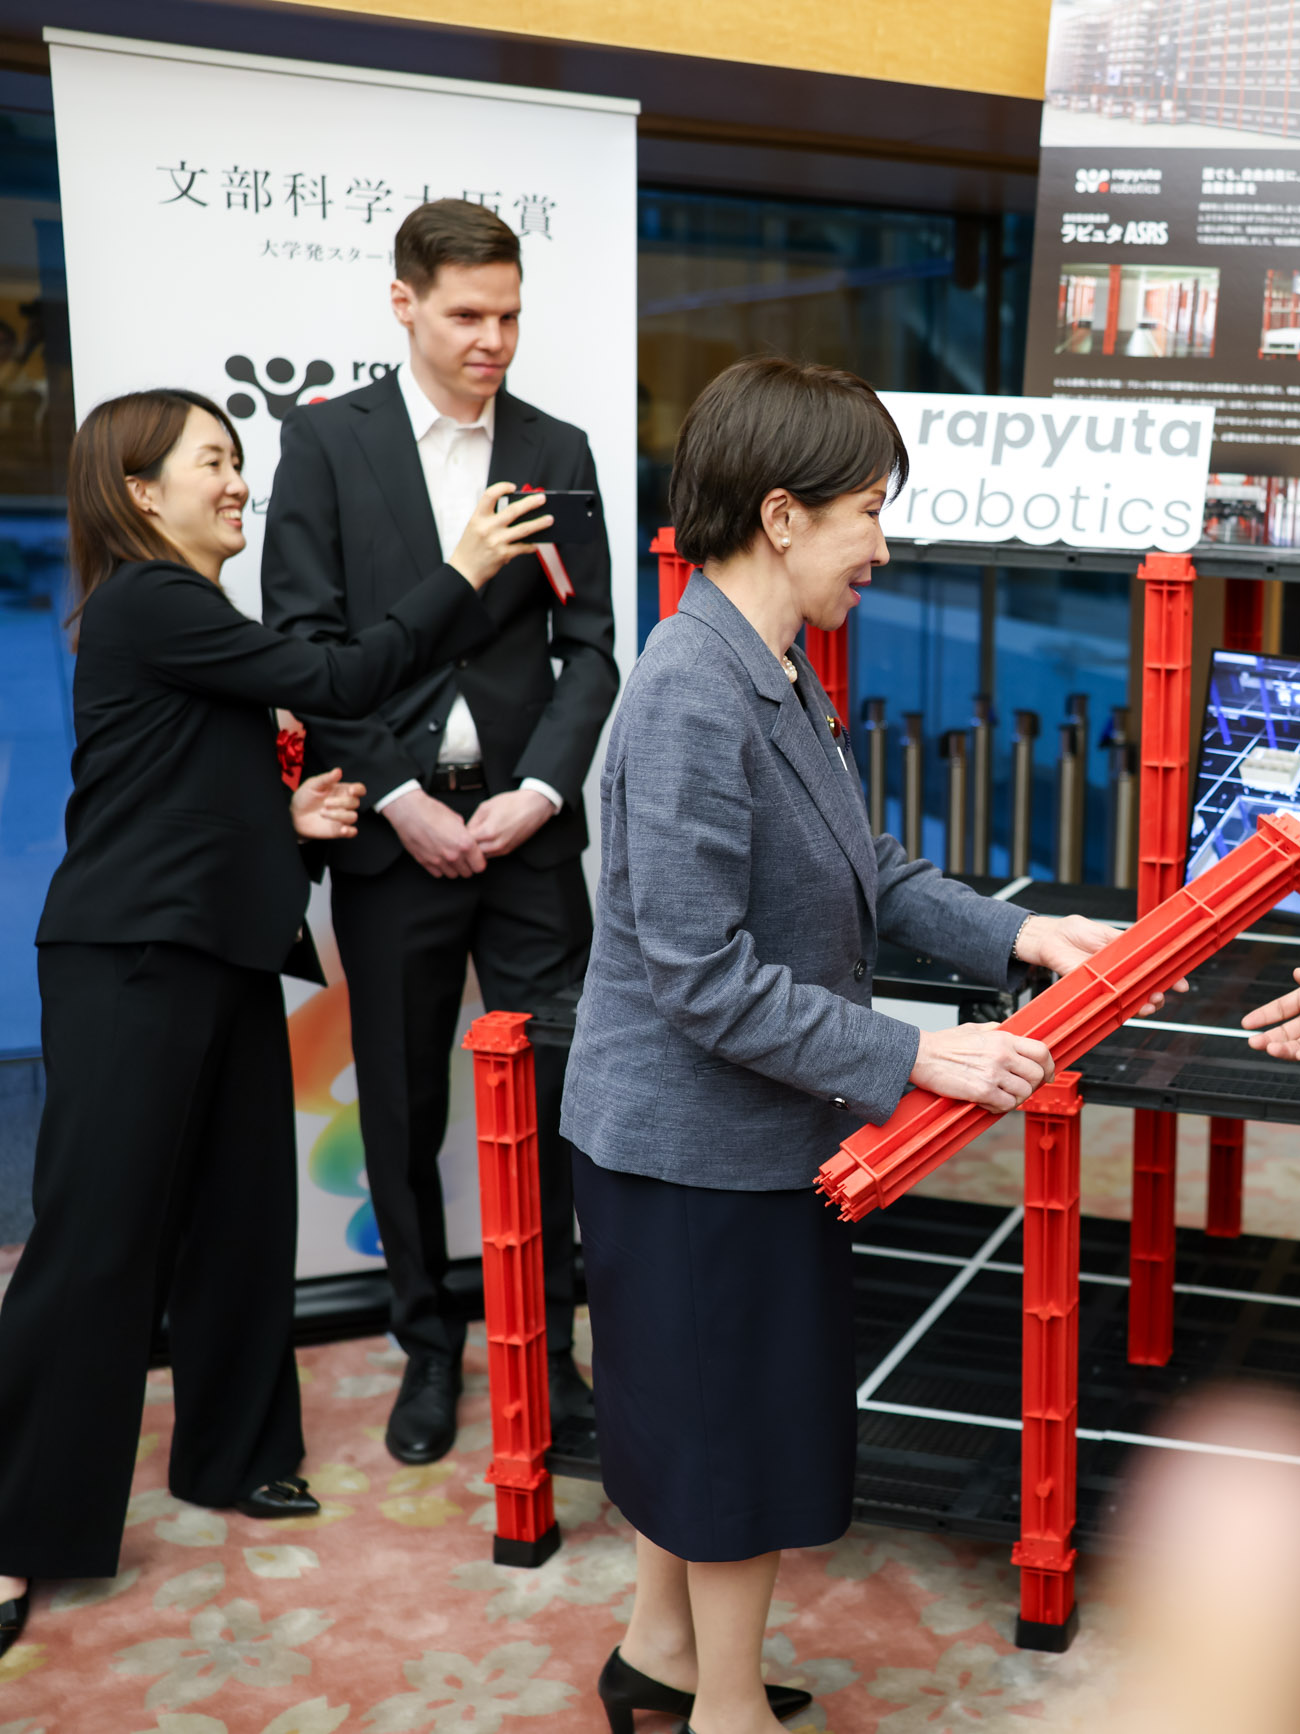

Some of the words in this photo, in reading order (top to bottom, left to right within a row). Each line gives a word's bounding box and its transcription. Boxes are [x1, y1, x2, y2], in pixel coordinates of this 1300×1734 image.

[1124, 221, 1169, 245] ASRS
[918, 408, 1202, 468] rapyuta
[907, 478, 1192, 537] robotics
